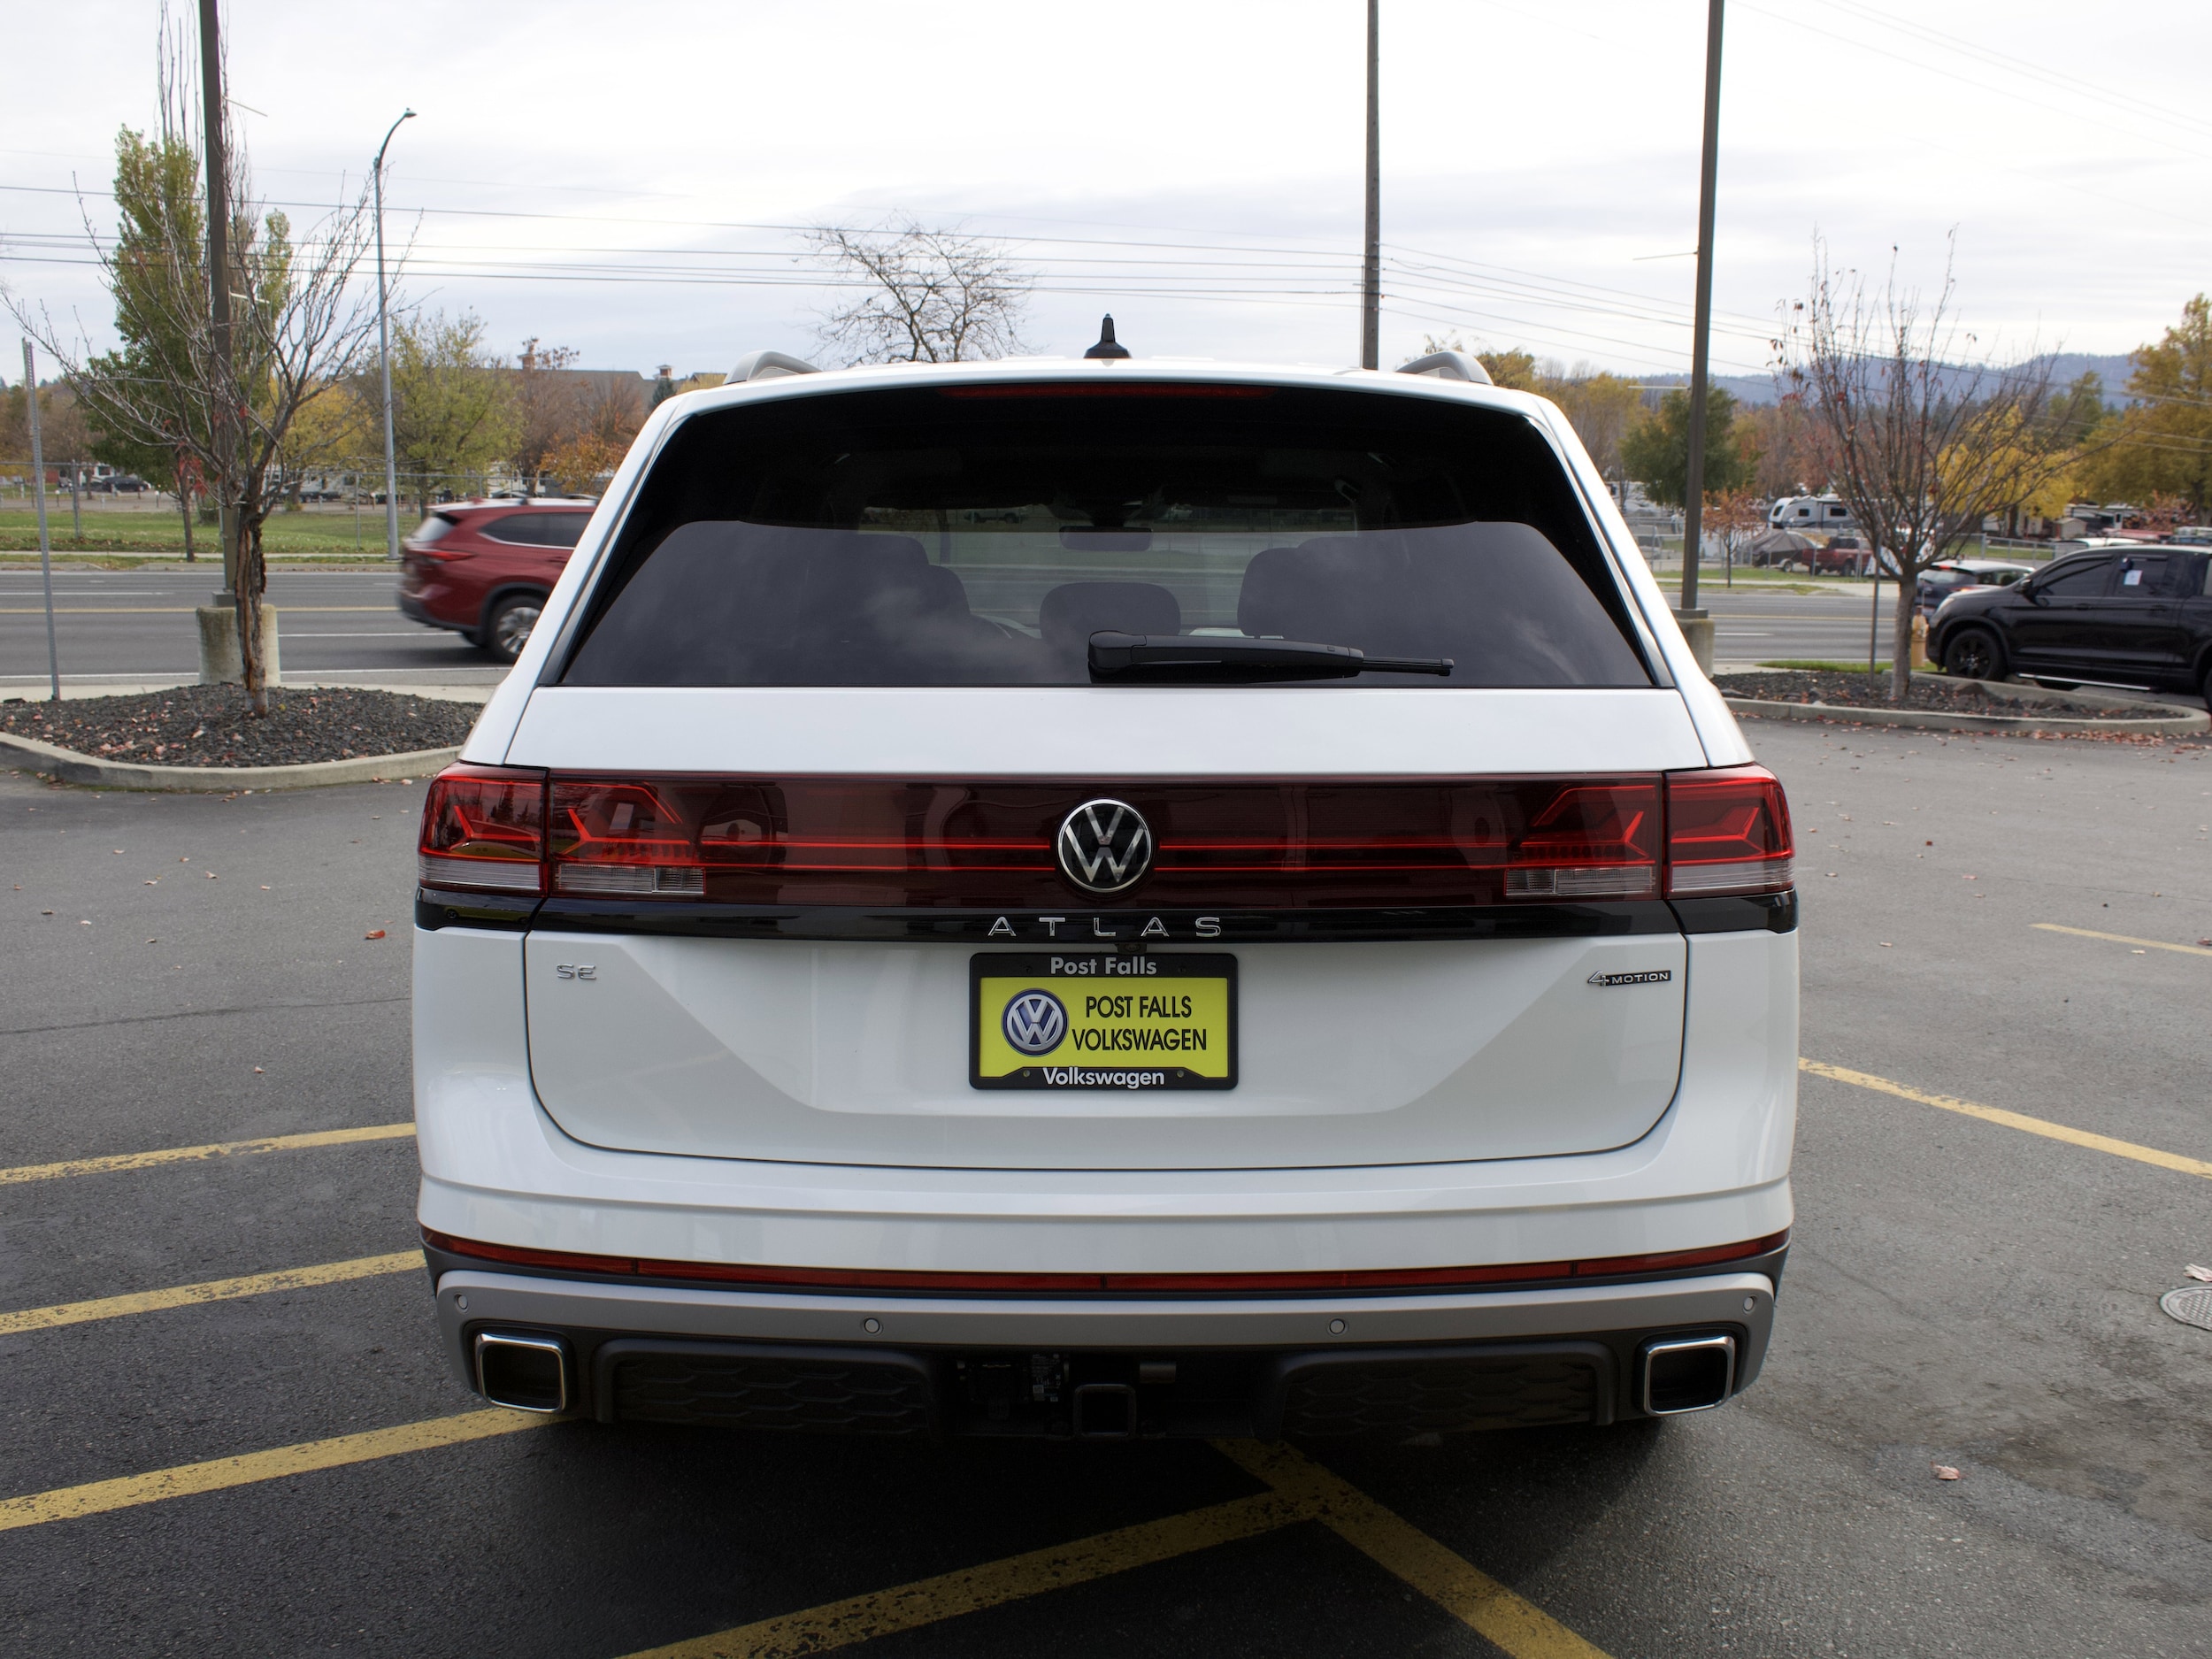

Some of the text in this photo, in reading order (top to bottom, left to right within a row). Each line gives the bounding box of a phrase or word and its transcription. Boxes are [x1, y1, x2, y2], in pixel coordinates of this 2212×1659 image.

[1064, 804, 1146, 884] VW
[987, 916, 1222, 938] ATLAS
[557, 963, 597, 980] SE
[1050, 956, 1157, 975] Post Falls
[1086, 995, 1193, 1018] POST FALLS
[1005, 993, 1064, 1052] VW
[1071, 1028, 1207, 1051] VOLKSWAGEN
[1042, 1066, 1165, 1089] Volkswagen
